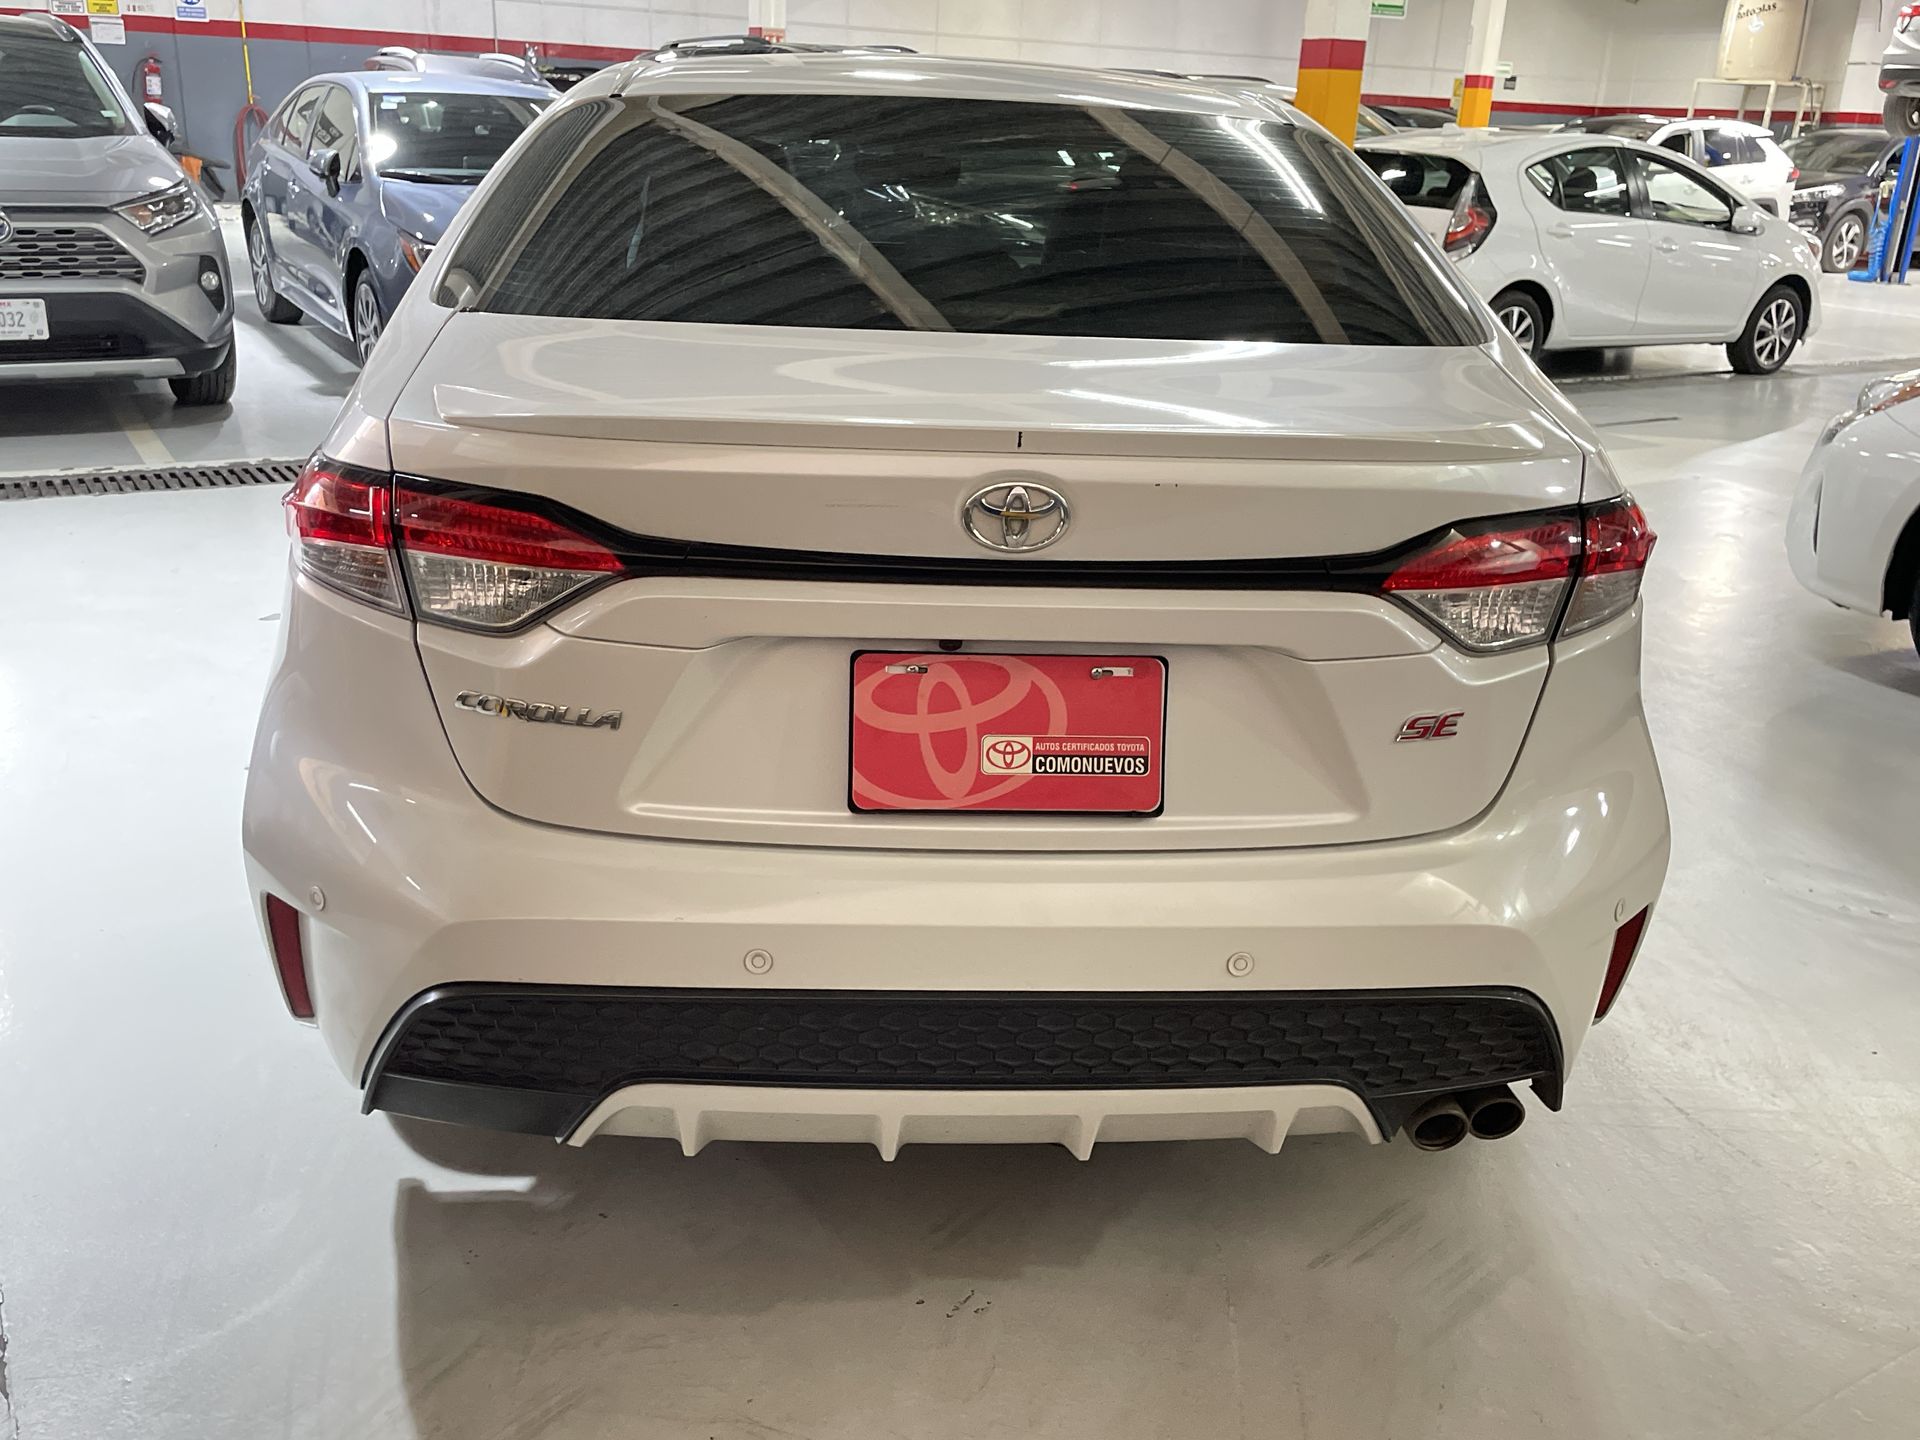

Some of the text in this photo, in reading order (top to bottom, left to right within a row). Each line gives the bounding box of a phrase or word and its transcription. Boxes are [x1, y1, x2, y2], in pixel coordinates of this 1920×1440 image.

[454, 690, 622, 731] COROLLA
[1395, 710, 1465, 743] SE
[1035, 742, 1145, 752] AUTOS CERTIFICADOS TOYOTA
[1035, 756, 1145, 774] COMONUEVOS
